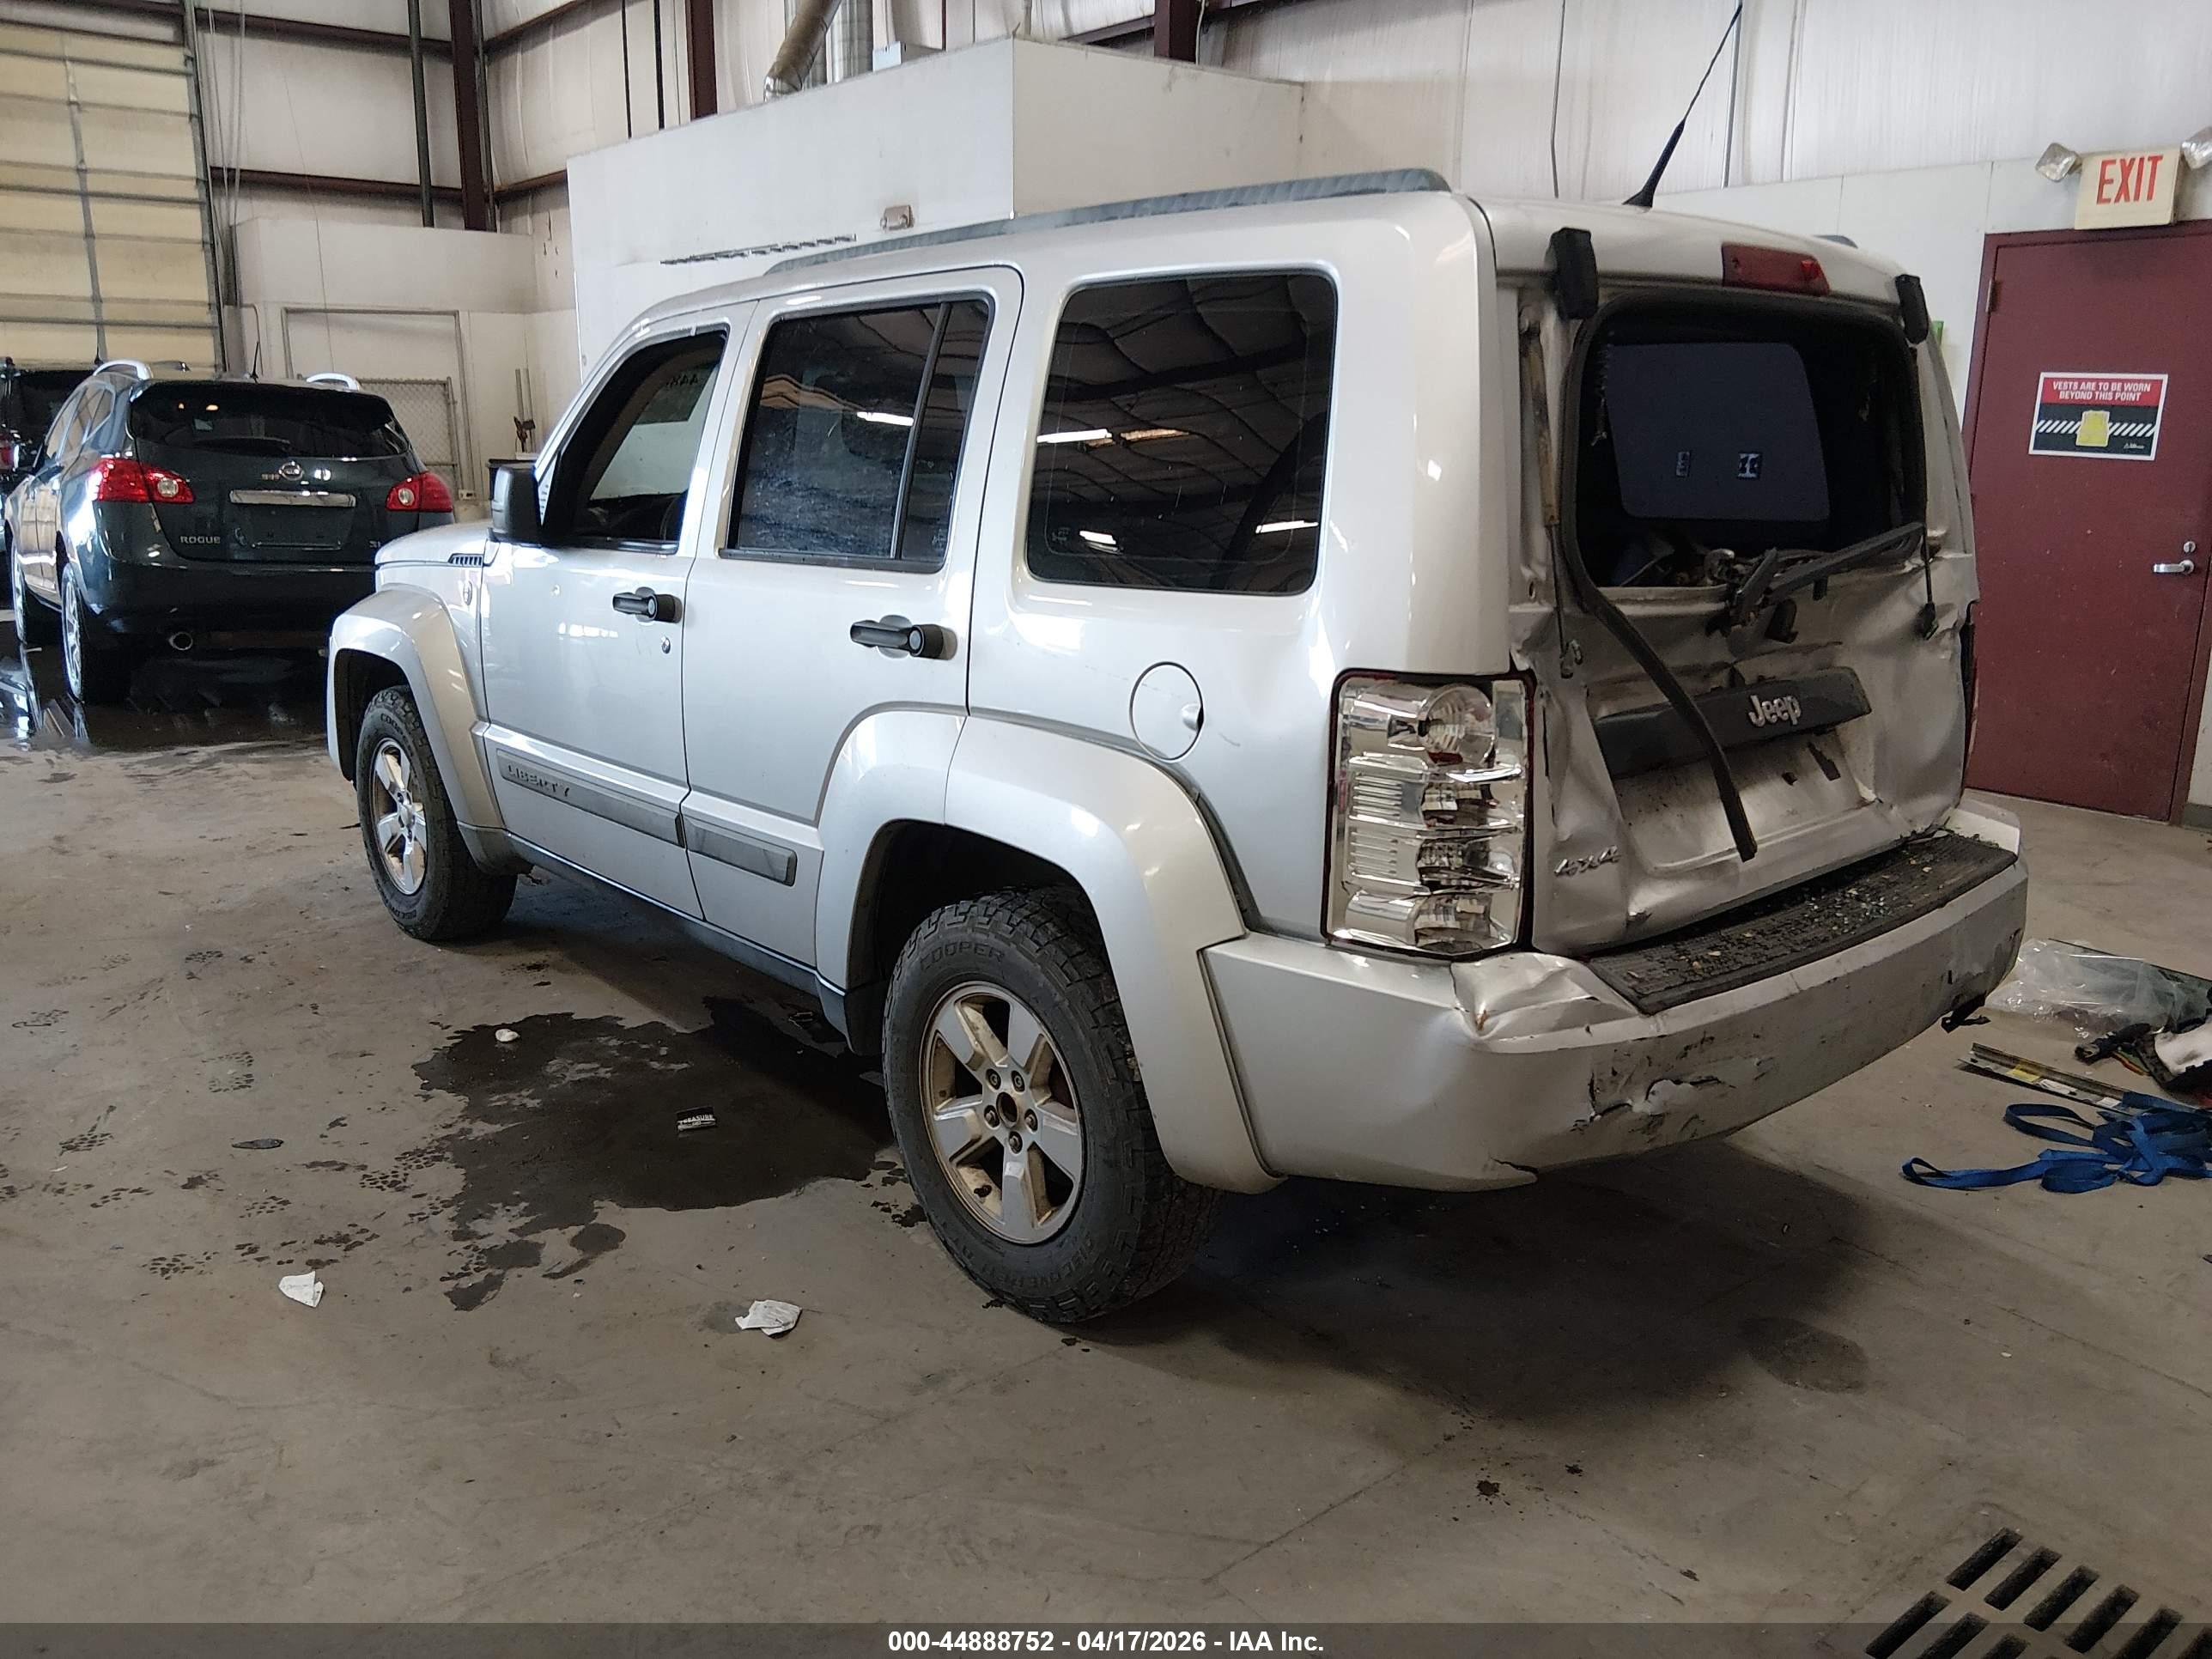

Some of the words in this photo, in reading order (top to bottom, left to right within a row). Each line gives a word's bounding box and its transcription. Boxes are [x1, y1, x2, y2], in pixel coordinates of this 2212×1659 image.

[2096, 155, 2163, 204] EXIT
[2052, 380, 2079, 390] VESTS
[2080, 382, 2096, 391] ARE
[2098, 382, 2110, 391] TO
[2111, 382, 2123, 392] BE
[2124, 382, 2151, 392] WORN
[2058, 391, 2093, 400] BEYOND
[2095, 391, 2114, 400] THIS
[2114, 392, 2142, 401] POINT
[179, 535, 221, 544] ROGUE
[1748, 694, 1802, 727] Jeep
[508, 764, 570, 798] LIBERTY
[920, 940, 1005, 969] COOPER
